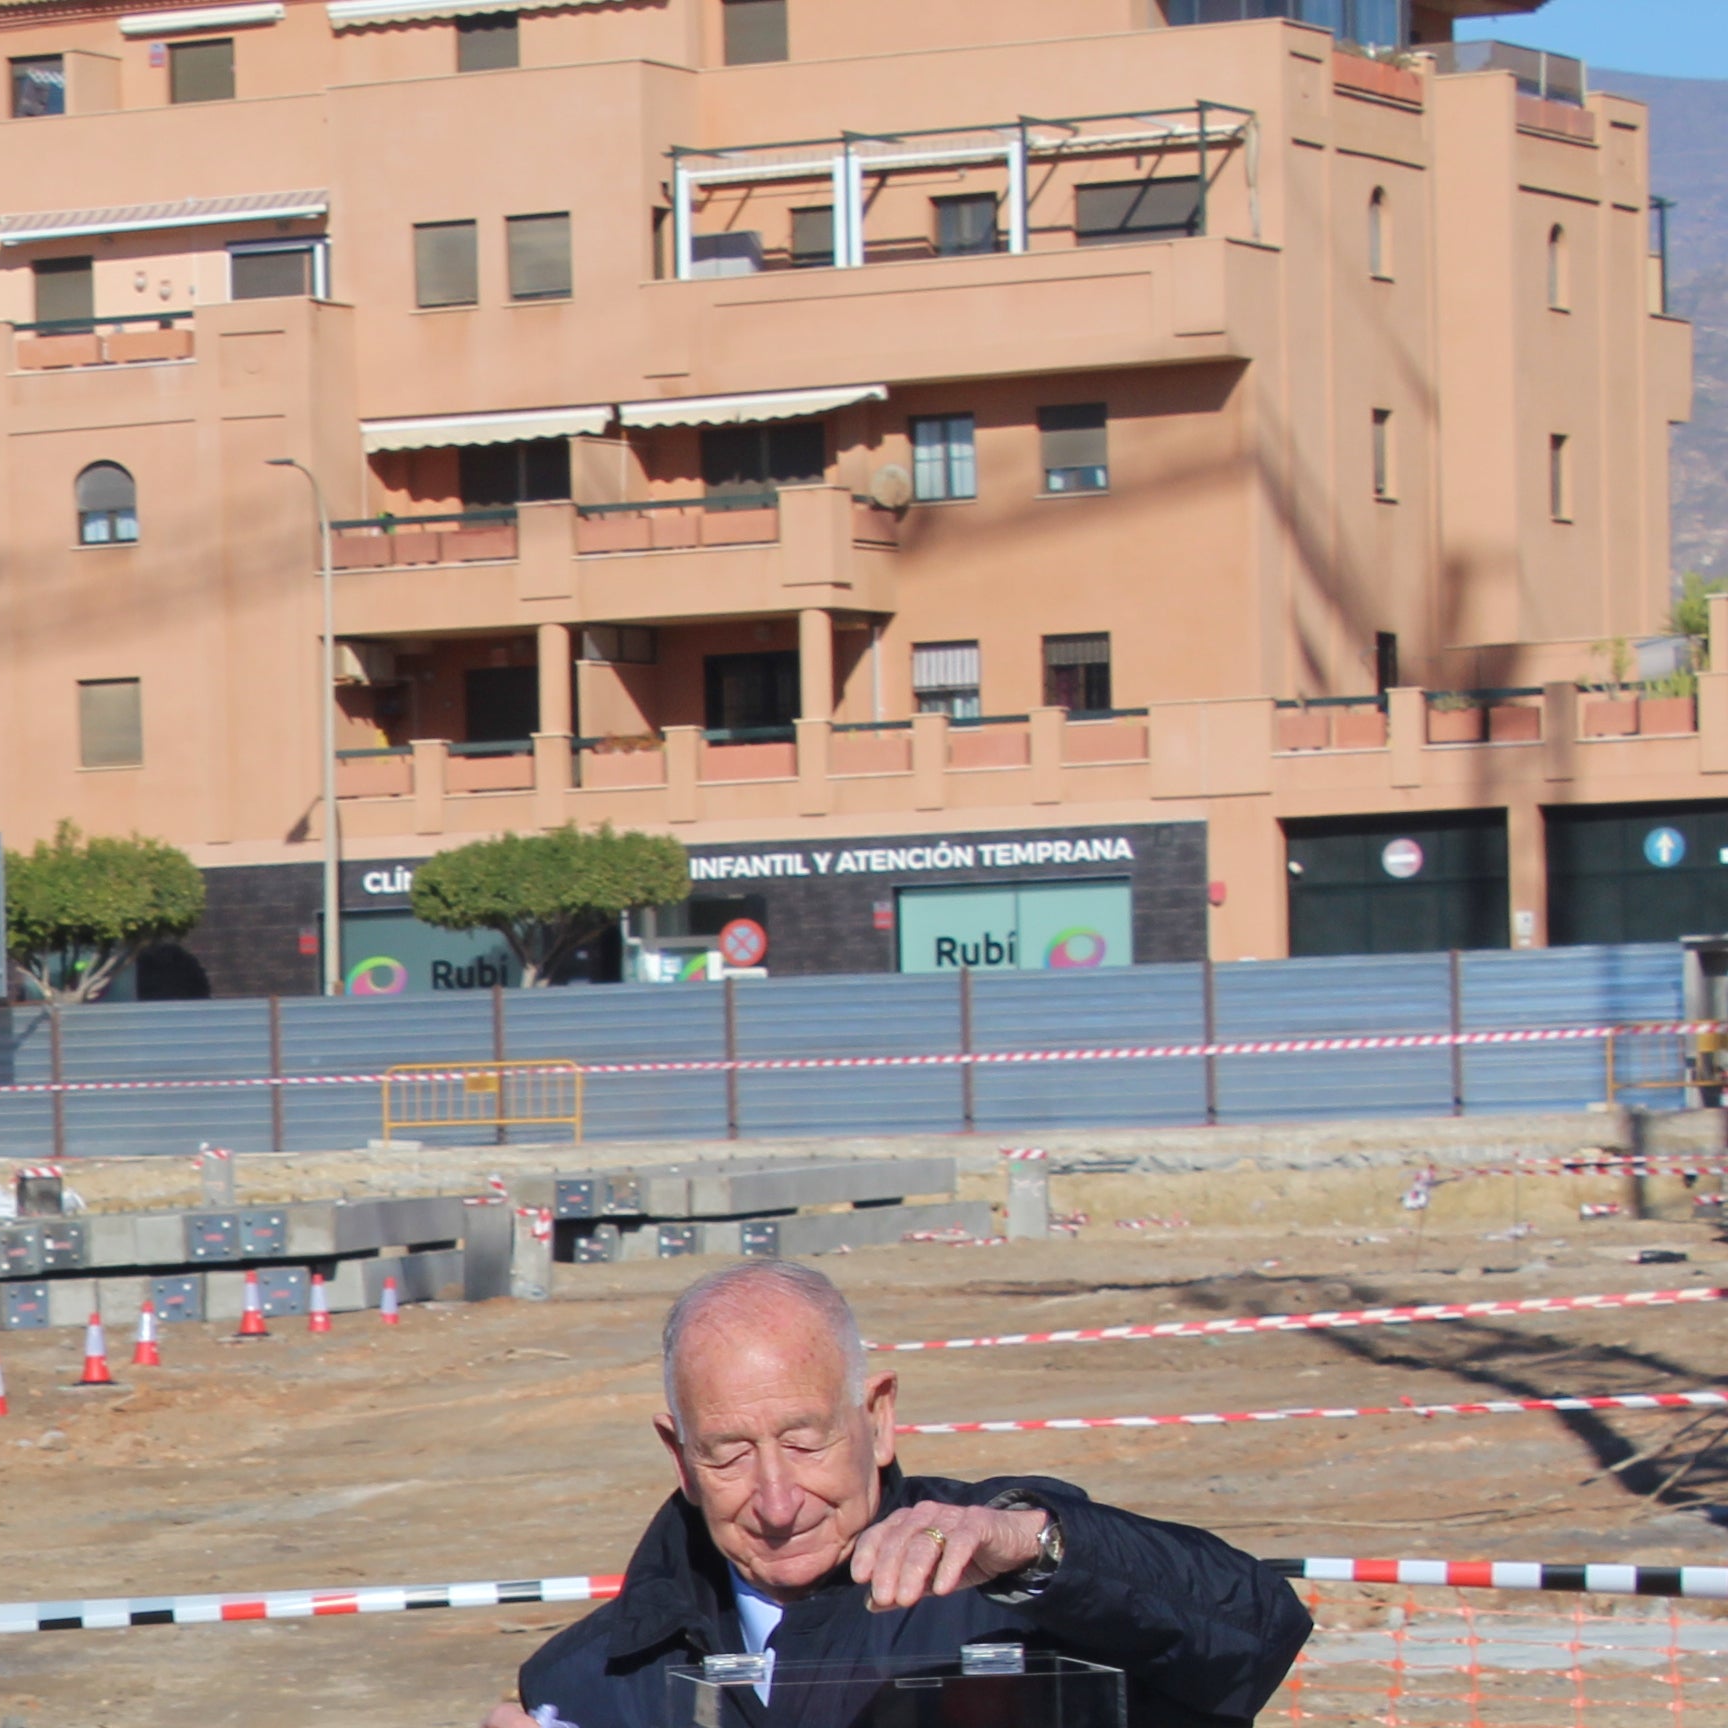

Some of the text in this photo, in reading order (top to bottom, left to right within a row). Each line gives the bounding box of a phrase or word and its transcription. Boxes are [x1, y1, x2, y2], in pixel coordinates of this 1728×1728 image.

[689, 854, 810, 880] INFANTIL
[813, 852, 834, 874] Y
[836, 841, 974, 873] ATENCIÓN
[978, 836, 1134, 866] TEMPRANA
[935, 931, 1016, 968] Rubí
